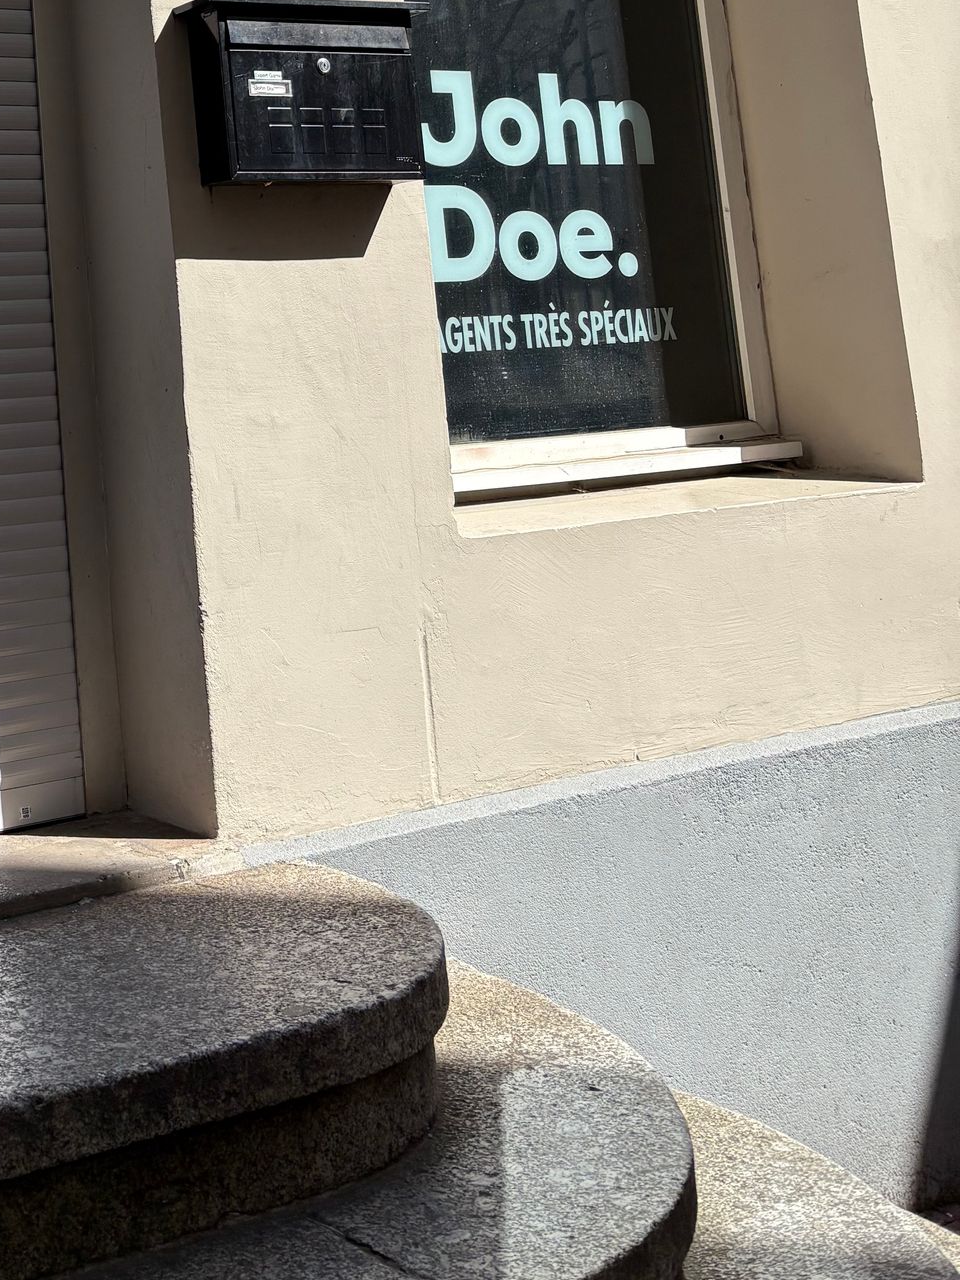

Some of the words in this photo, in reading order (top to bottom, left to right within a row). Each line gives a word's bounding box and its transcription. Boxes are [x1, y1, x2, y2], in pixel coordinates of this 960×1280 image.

[421, 69, 655, 167] John
[424, 184, 639, 283] Doe.
[520, 301, 574, 350] TRÈS
[578, 299, 678, 345] SPÉCIAUX
